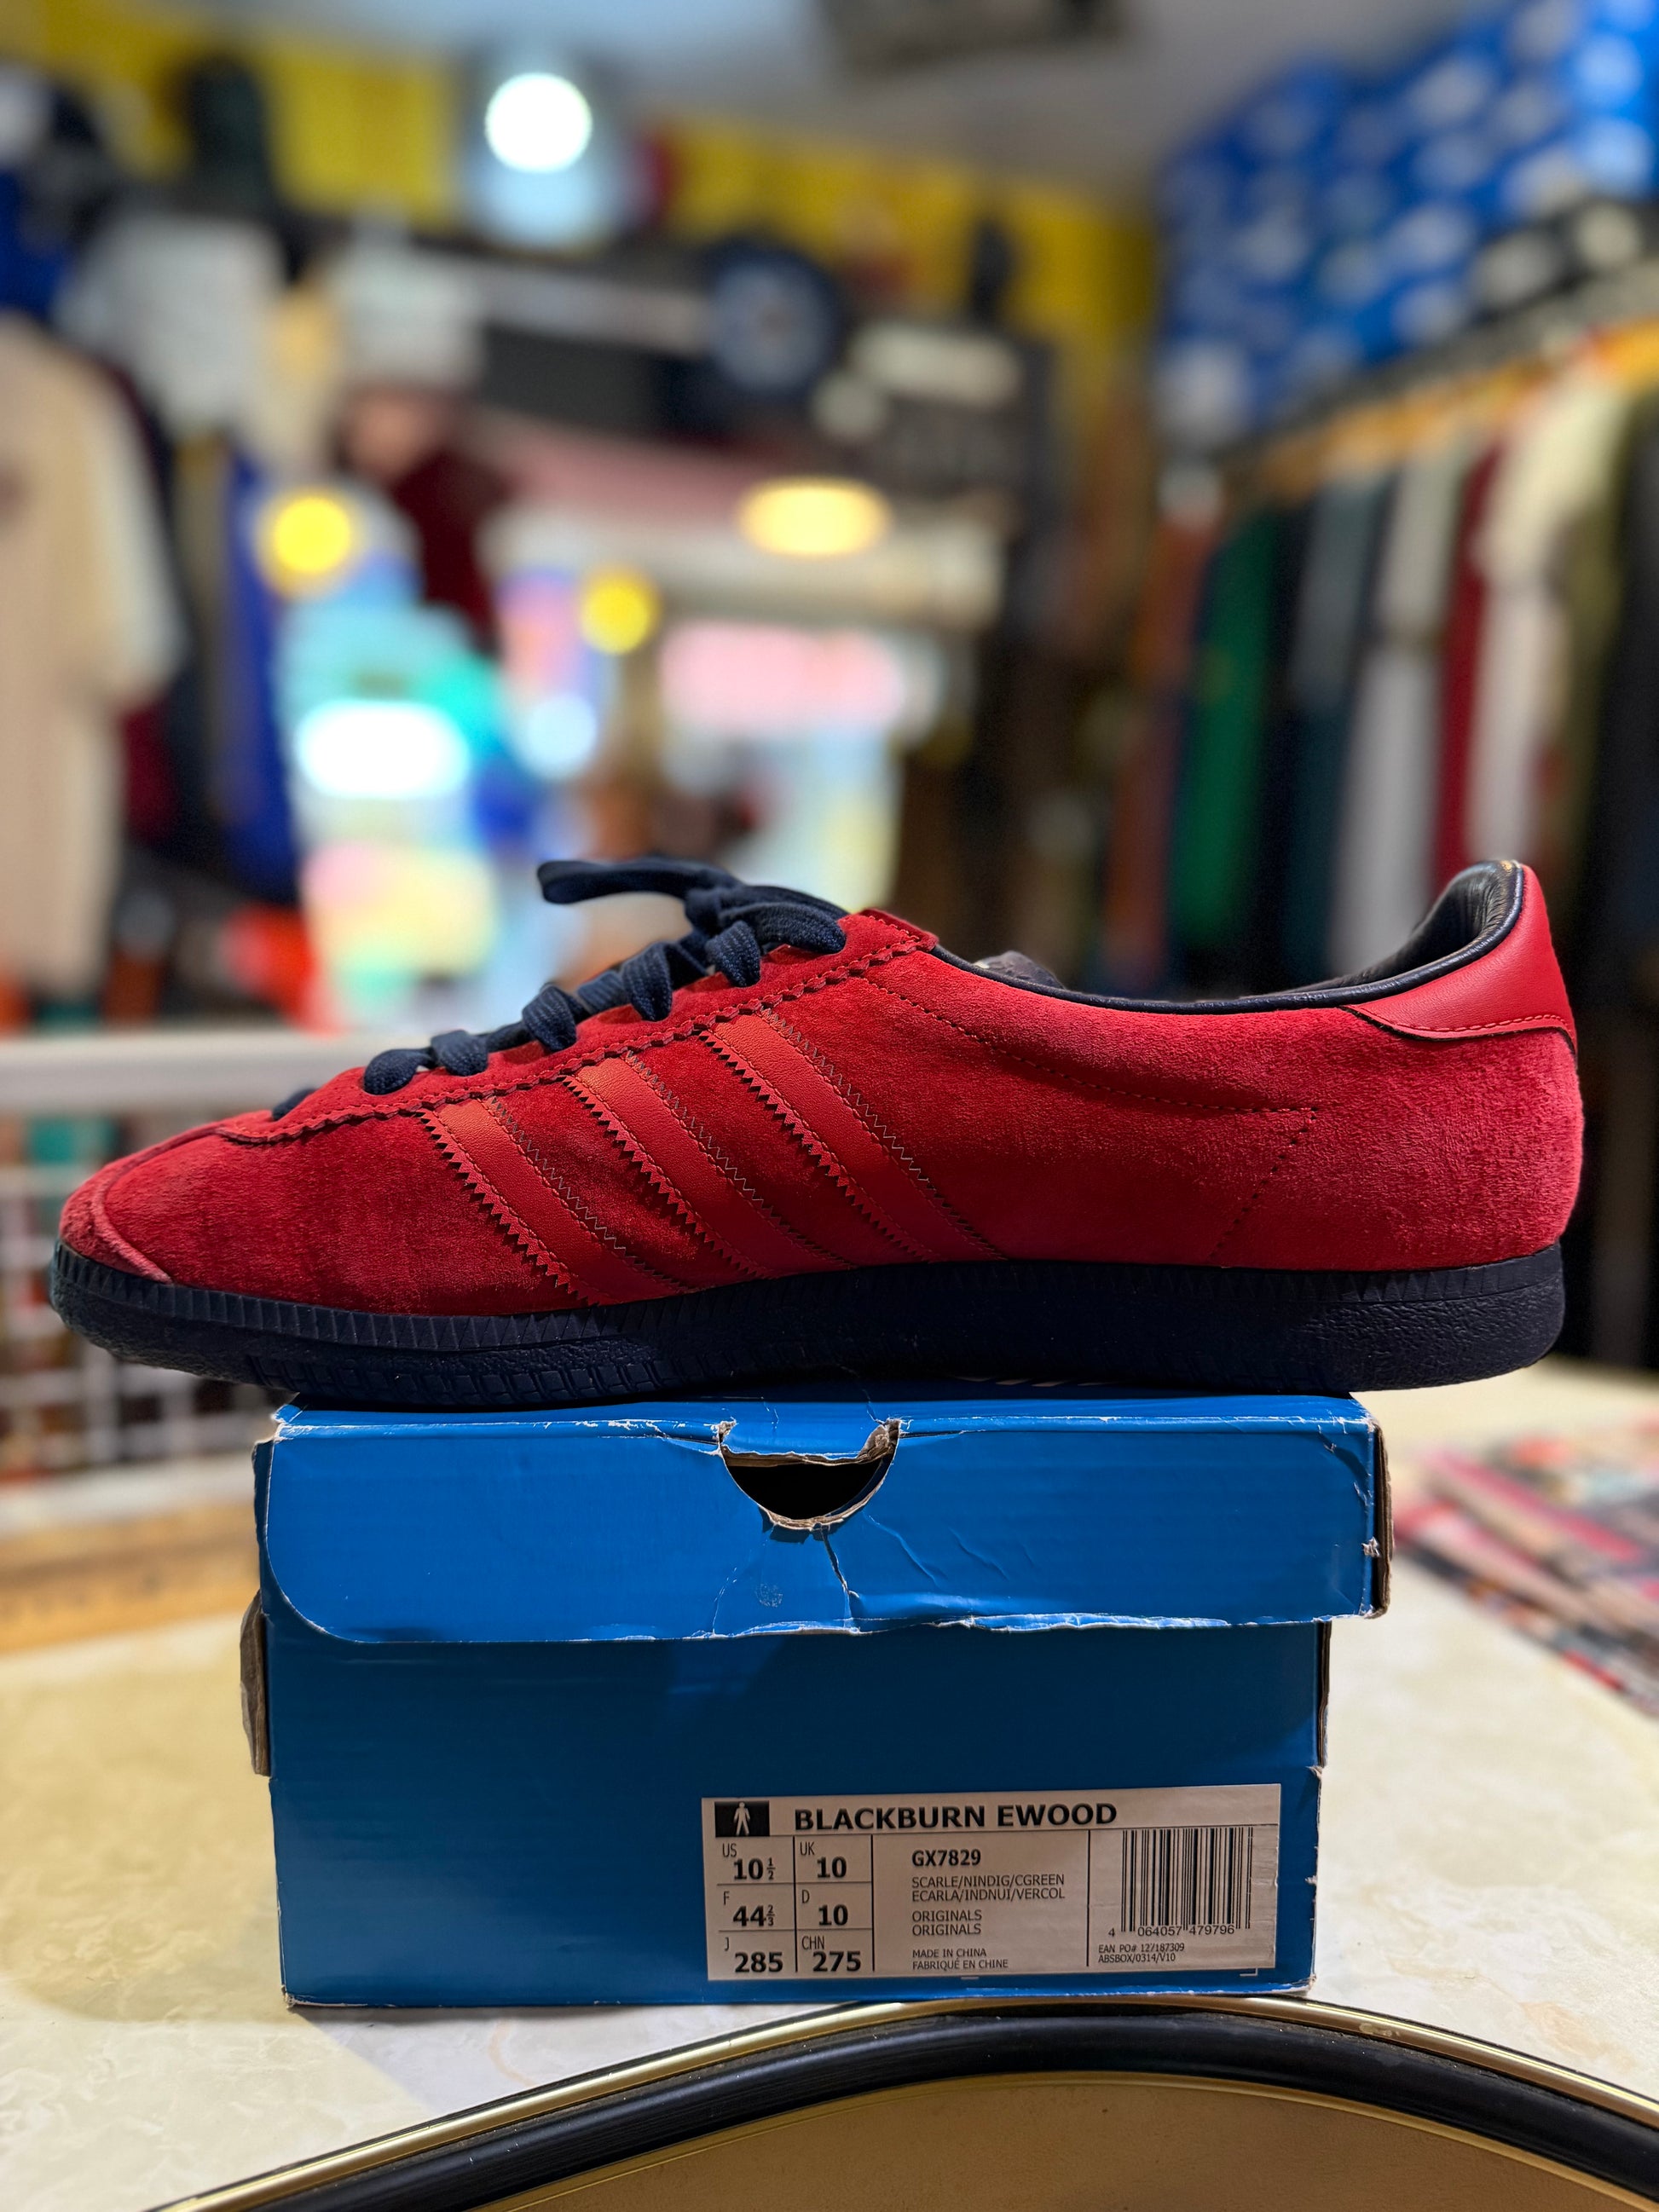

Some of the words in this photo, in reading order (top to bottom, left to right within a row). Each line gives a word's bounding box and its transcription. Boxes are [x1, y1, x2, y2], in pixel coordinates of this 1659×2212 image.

[795, 1805, 986, 1830] BLACKBURN
[997, 1803, 1118, 1827] EWOOD
[722, 1842, 737, 1857] US
[800, 1841, 814, 1856] UK
[911, 1849, 981, 1867] GX7829
[816, 1857, 847, 1879] 10
[911, 1874, 1065, 1889] SCARLE/NINDIG/CGREEN
[724, 1891, 730, 1904] F
[801, 1890, 810, 1903] D
[911, 1887, 1065, 1903] ECARLA/INDNUI/VERCOL
[818, 1904, 849, 1926] 10
[911, 1909, 982, 1923] ORIGINALS
[911, 1923, 982, 1937] ORIGINALS
[1136, 1926, 1182, 1938] 064057
[1188, 1925, 1235, 1936] 479796
[724, 1937, 731, 1952] J
[801, 1936, 825, 1950] CHN
[1098, 1944, 1115, 1954] EAN
[1119, 1944, 1136, 1953] PO#
[812, 1950, 862, 1972] 275
[912, 1949, 939, 1959] MADE
[943, 1949, 953, 1958] IN
[956, 1948, 987, 1958] CHINA
[1098, 1954, 1176, 1964] ABSBOX/0314/V10
[734, 1951, 784, 1973] 285
[912, 1958, 960, 1972] FABRIQUÉ
[963, 1961, 975, 1969] EN
[979, 1959, 1009, 1968] CHINE
